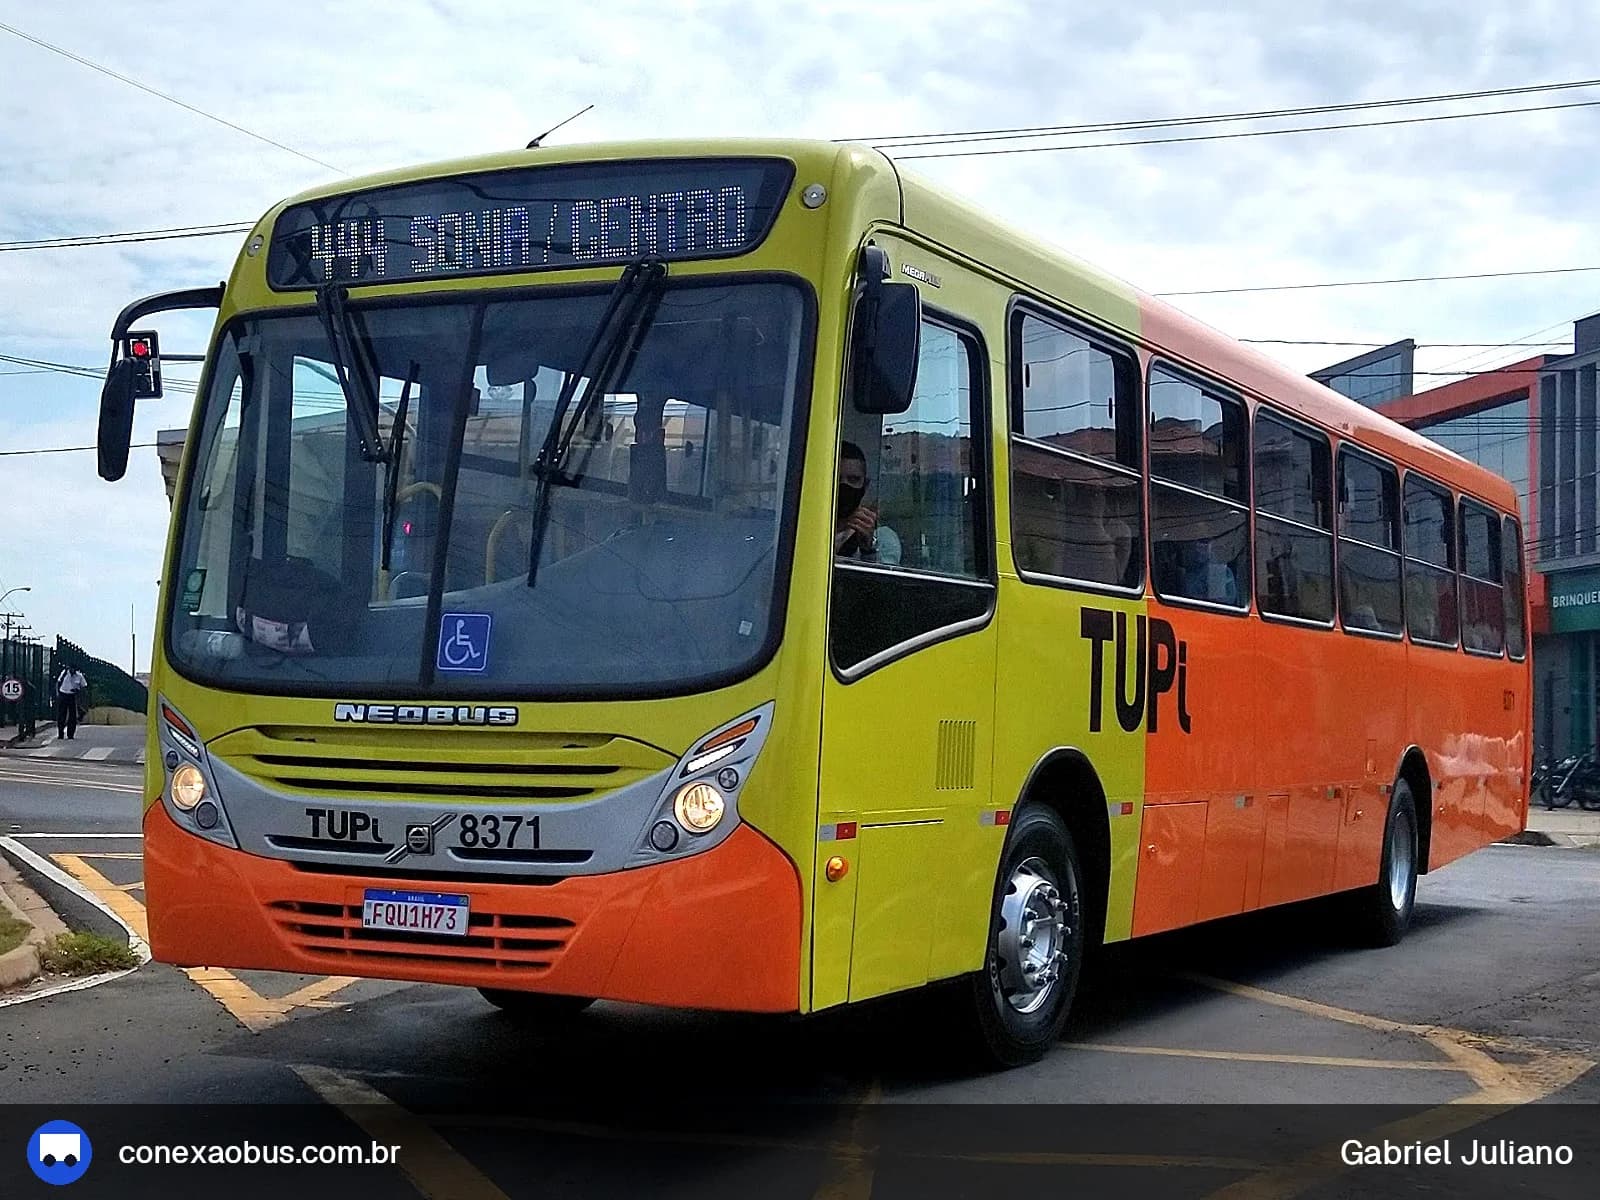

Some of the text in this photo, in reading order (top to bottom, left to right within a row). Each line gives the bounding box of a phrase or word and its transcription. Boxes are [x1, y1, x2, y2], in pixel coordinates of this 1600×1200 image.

[311, 220, 388, 280] 444
[410, 206, 529, 273] SONIA
[571, 185, 745, 261] CENTRO
[5, 683, 19, 693] 15
[334, 702, 519, 725] NEOBUS
[459, 813, 541, 849] 8371
[372, 902, 457, 930] FQU1H73
